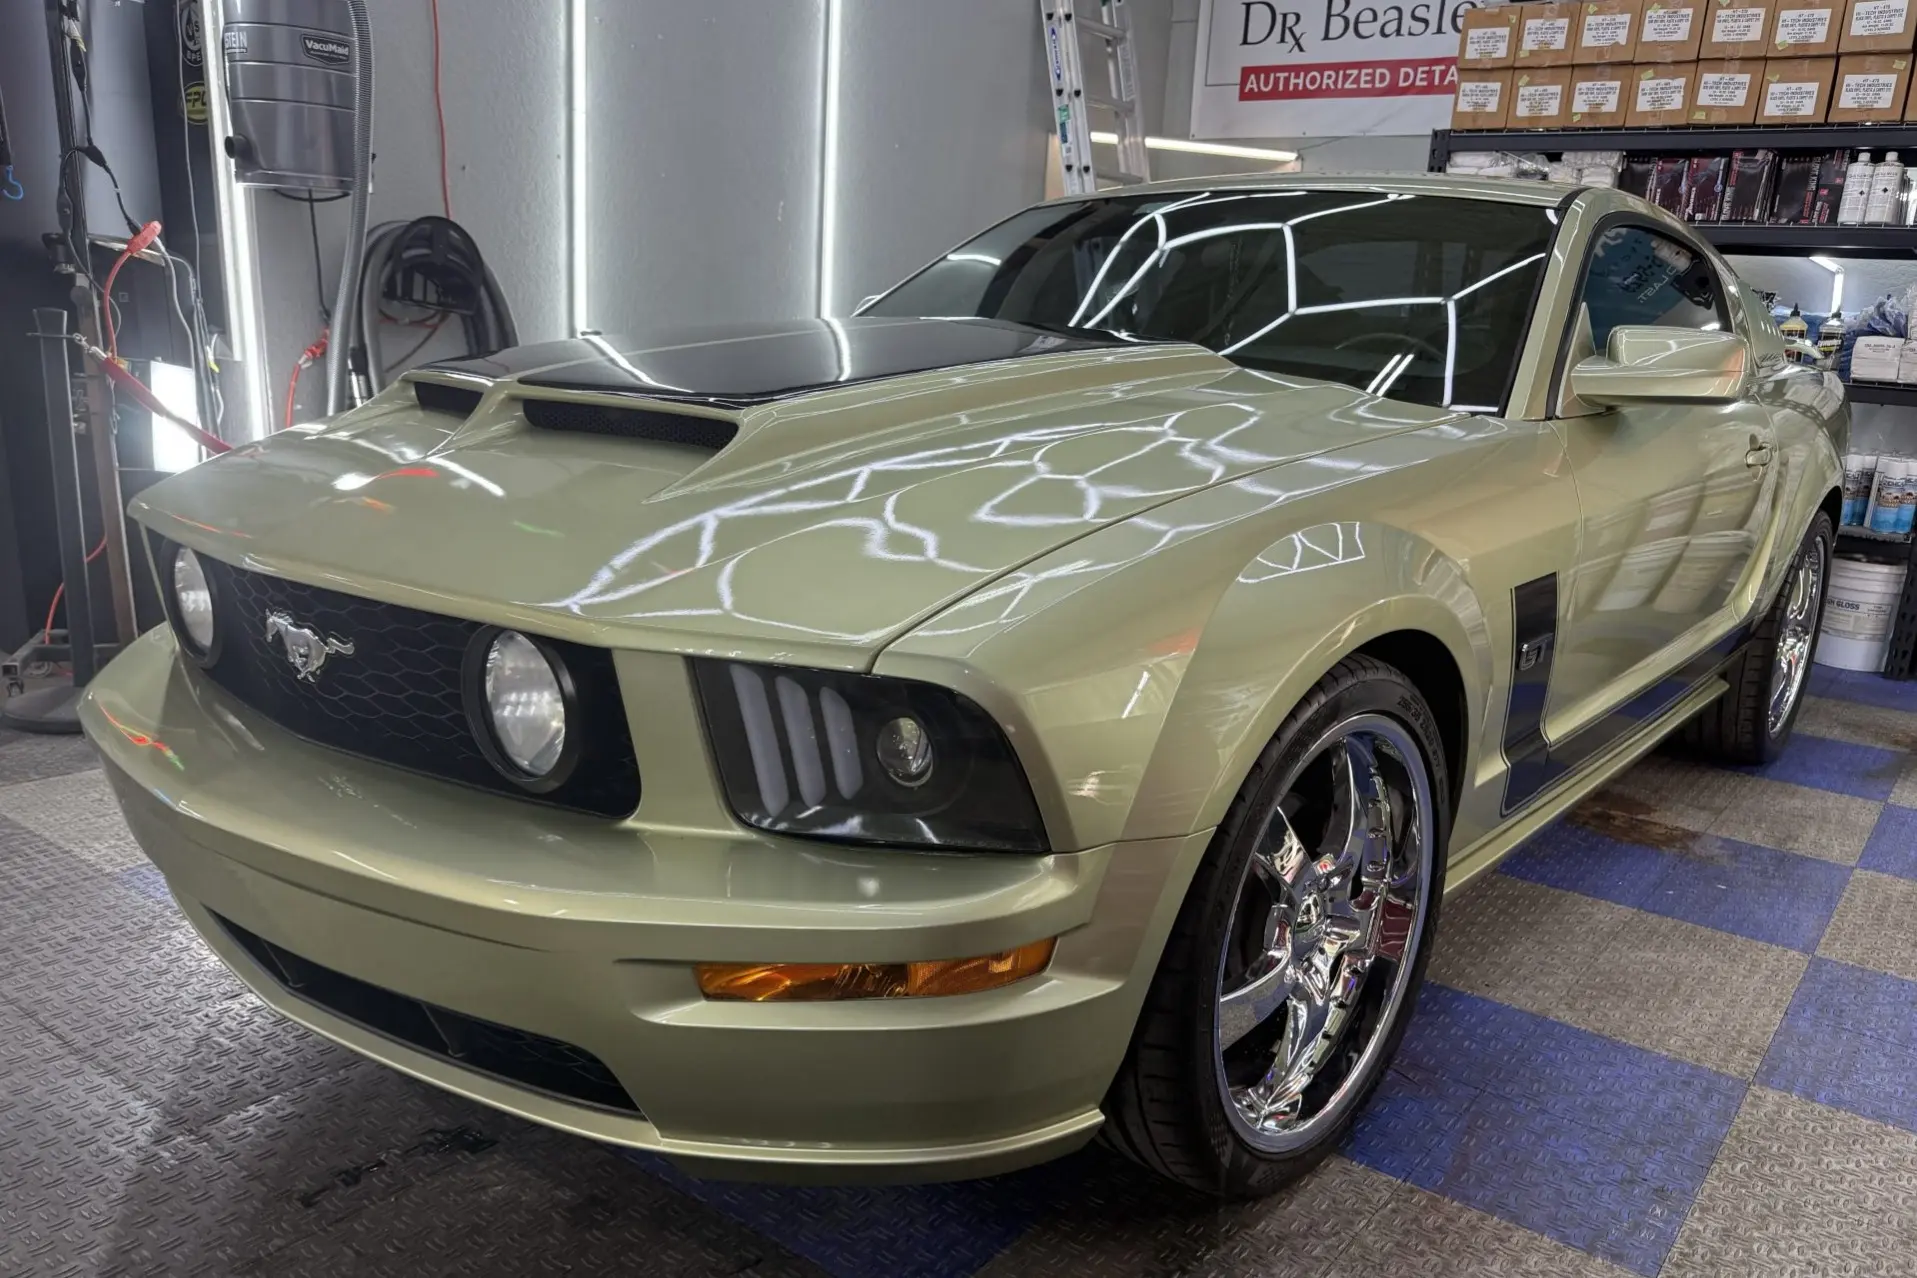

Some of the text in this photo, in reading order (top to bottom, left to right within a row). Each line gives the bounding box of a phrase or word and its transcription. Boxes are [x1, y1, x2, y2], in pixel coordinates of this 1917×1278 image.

[305, 39, 349, 56] VacuMaid
[1244, 65, 1458, 93] AUTHORIZED DETA
[1836, 601, 1860, 611] GLOSS
[1520, 632, 1554, 670] GT
